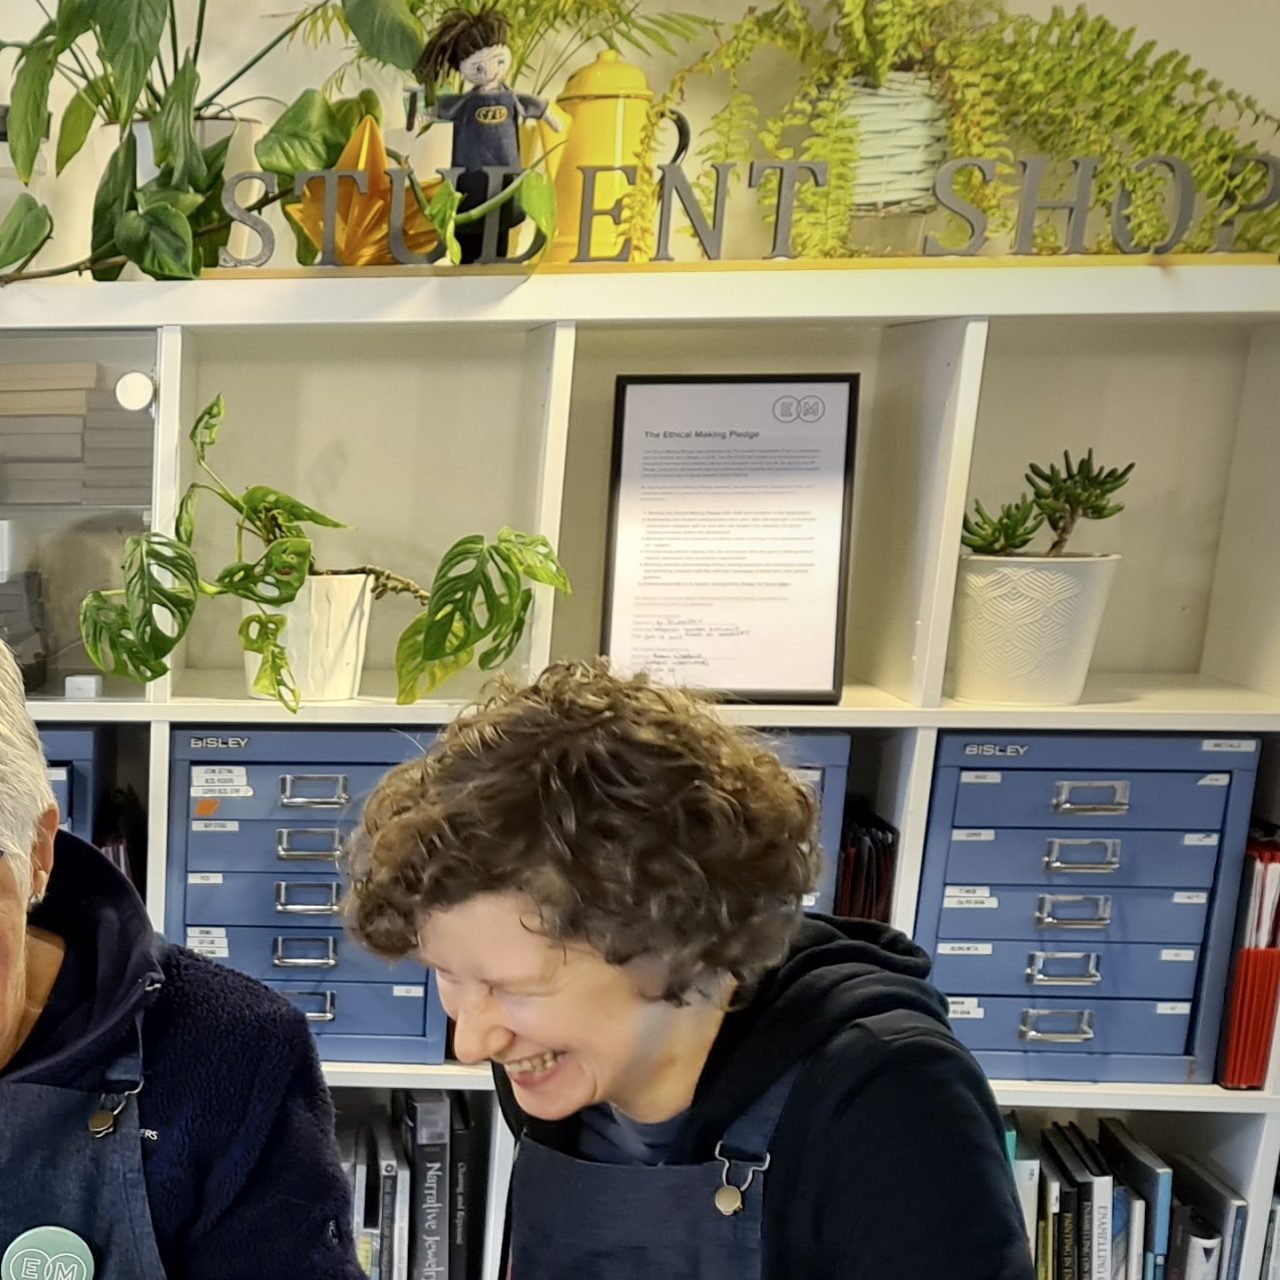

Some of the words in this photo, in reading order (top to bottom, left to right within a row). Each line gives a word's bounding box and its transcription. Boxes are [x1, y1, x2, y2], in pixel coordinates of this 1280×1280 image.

[220, 160, 827, 267] STUDENT
[644, 430, 661, 439] The
[663, 430, 692, 439] Ethical
[694, 430, 727, 440] Making
[729, 430, 760, 440] Pledge
[190, 737, 248, 749] BISLEY
[965, 744, 1028, 757] BISLEY
[422, 1162, 443, 1230] Narrative
